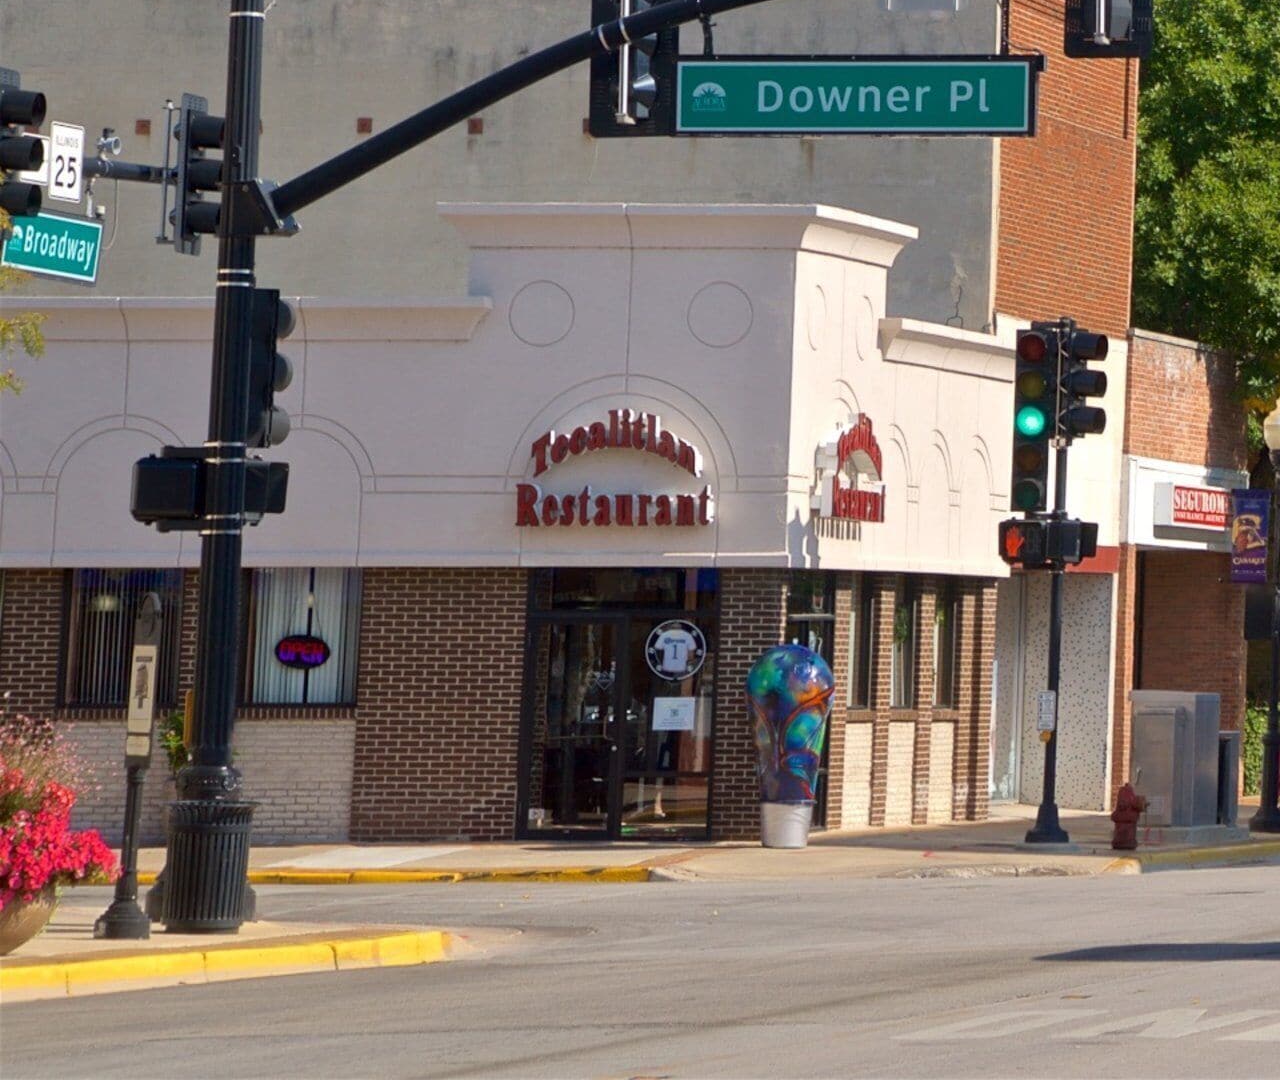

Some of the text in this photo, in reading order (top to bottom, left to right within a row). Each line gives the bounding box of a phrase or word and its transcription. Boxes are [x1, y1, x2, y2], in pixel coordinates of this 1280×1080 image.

[757, 78, 990, 113] Downer Pl
[55, 134, 79, 148] ILLINOIS
[54, 154, 77, 189] 25
[23, 224, 96, 271] Broadway
[531, 408, 703, 478] Tecalitlan
[515, 483, 715, 527] Restaurant
